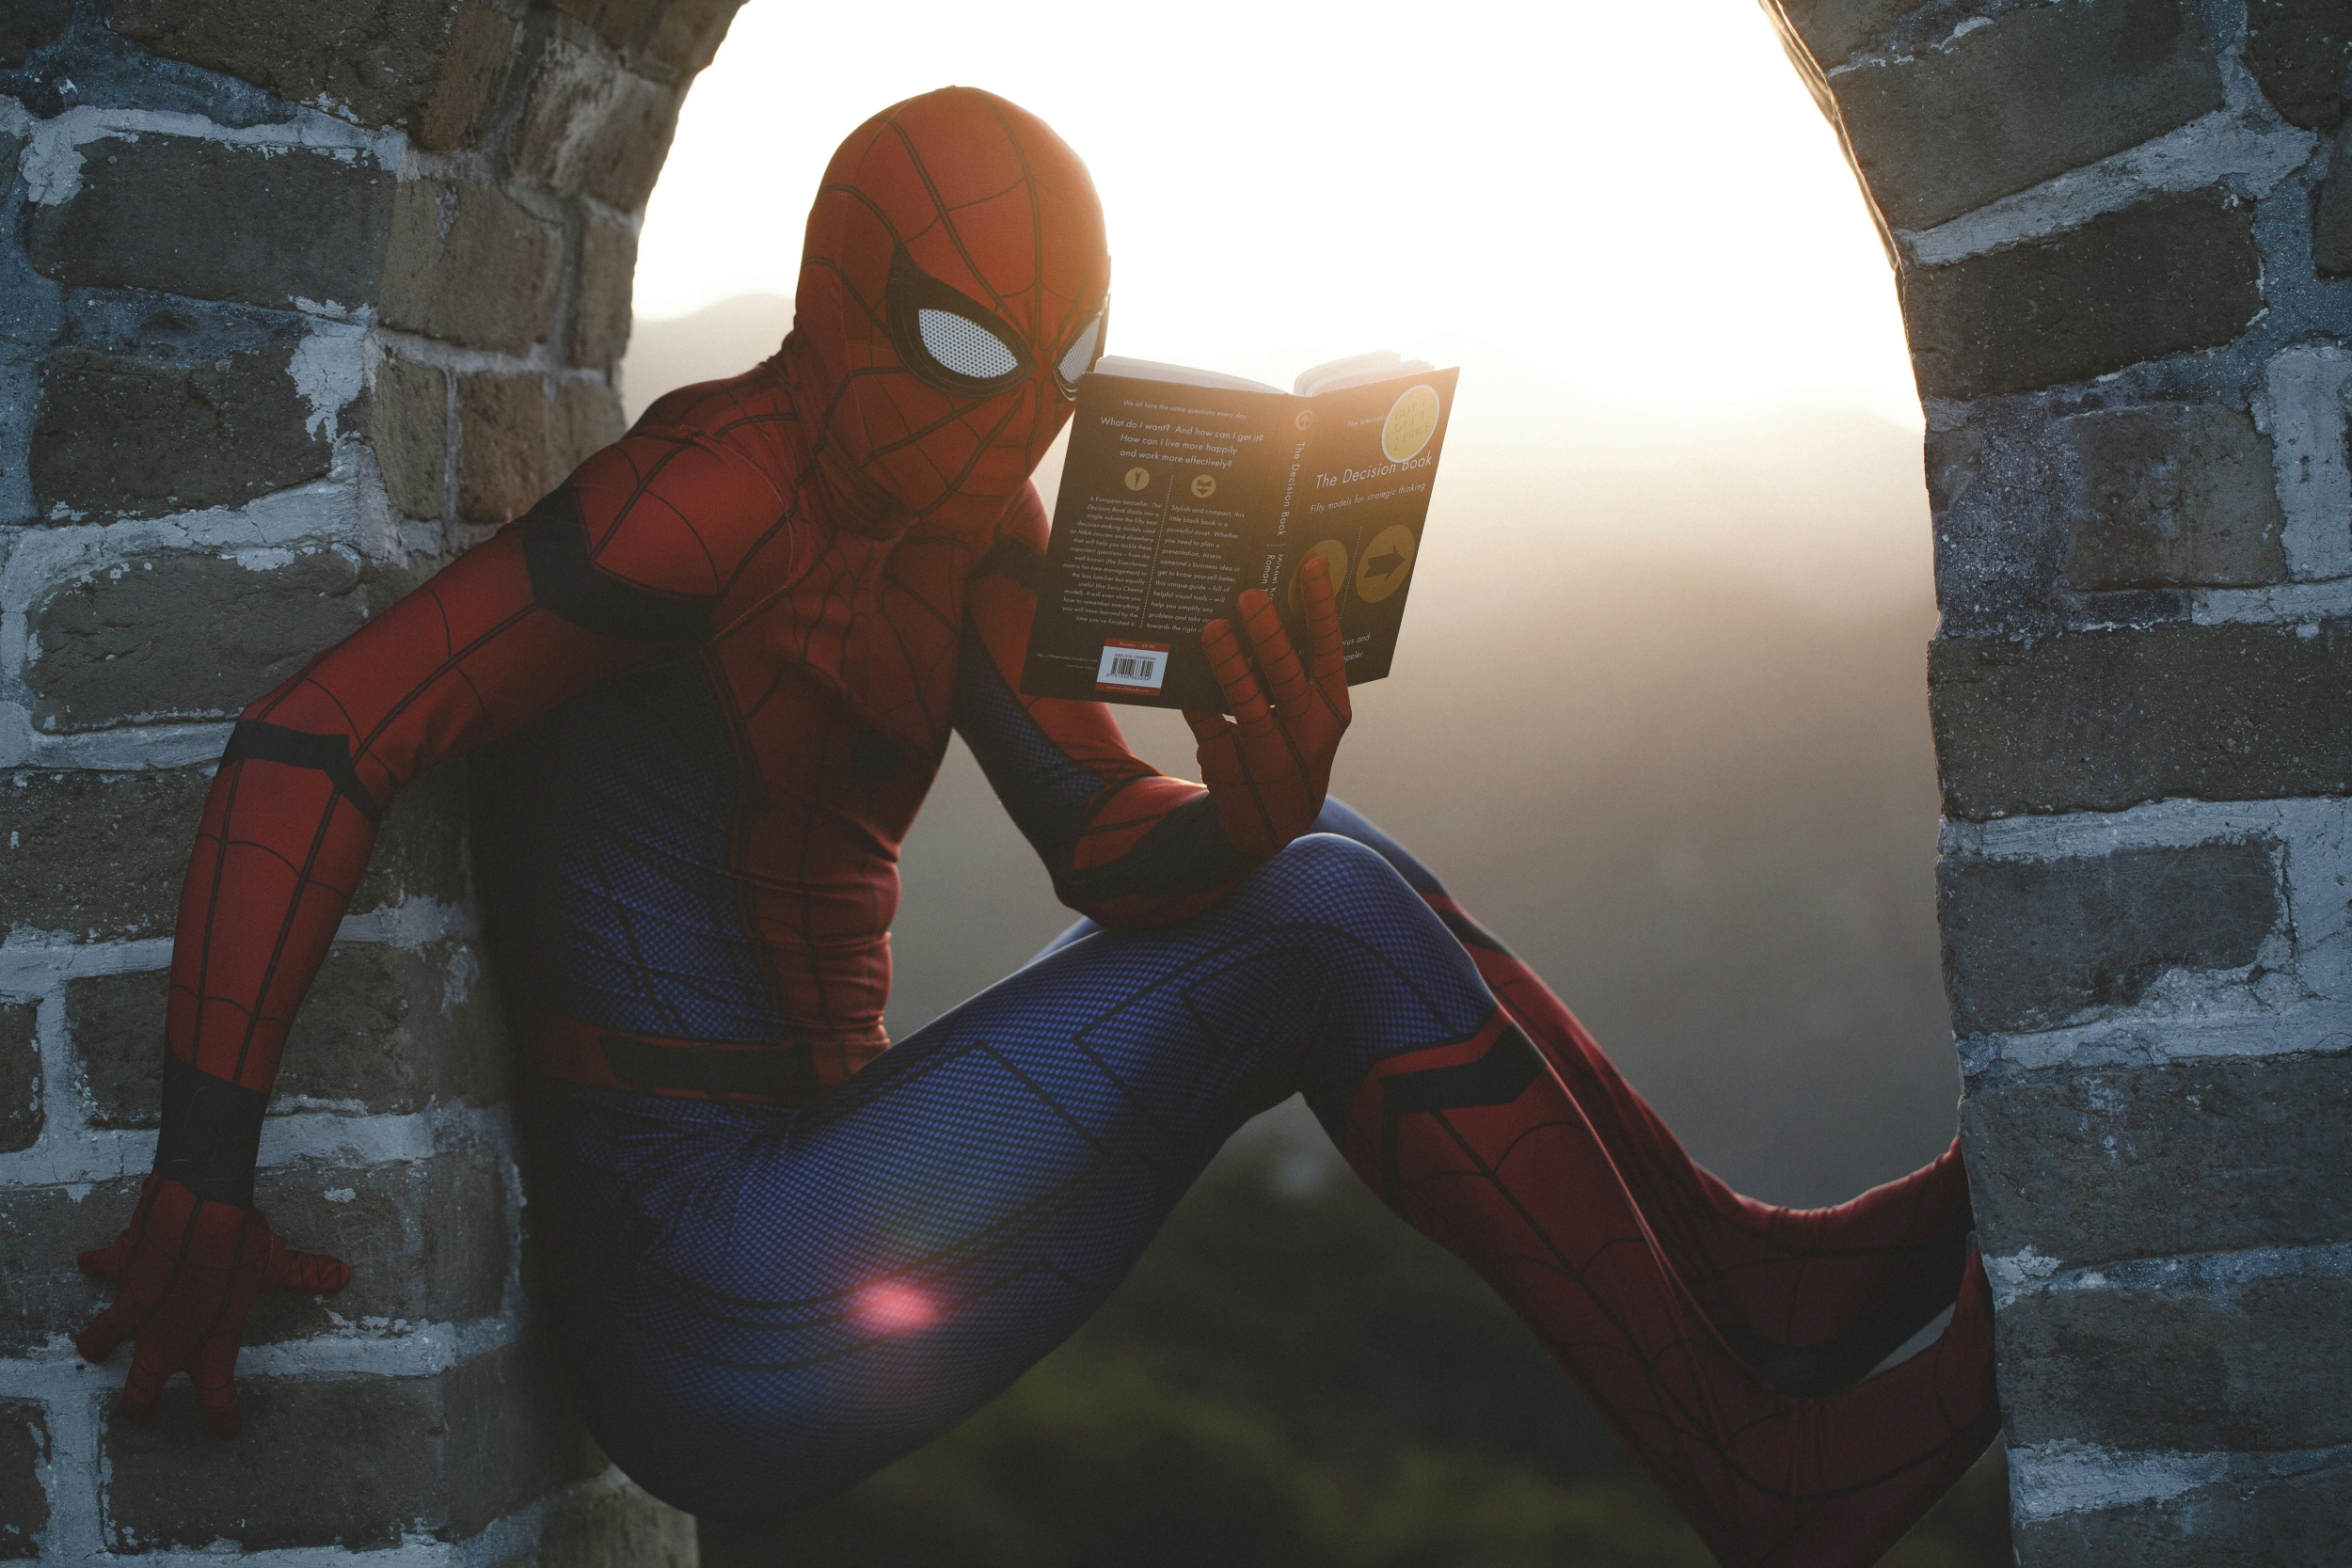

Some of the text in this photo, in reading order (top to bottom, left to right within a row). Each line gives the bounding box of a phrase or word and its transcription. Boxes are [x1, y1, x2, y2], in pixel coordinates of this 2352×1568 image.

[1359, 415, 1388, 425] Internatio
[1395, 402, 1417, 420] BUY
[1101, 417, 1124, 427] What
[1126, 420, 1136, 428] do
[1175, 426, 1192, 435] And
[1195, 428, 1213, 436] how
[1237, 434, 1251, 442] get
[1394, 416, 1414, 432] GET
[1404, 421, 1429, 443] PRICE
[1120, 434, 1140, 443] How
[1166, 438, 1180, 448] live
[1183, 442, 1203, 451] more
[1206, 443, 1237, 455] happily
[1162, 454, 1183, 463] more
[1185, 456, 1232, 469] effectively?
[1316, 451, 1432, 489] The Decision Book
[1277, 441, 1305, 536] The Decision Book
[1311, 483, 1425, 514] Fifty models for strategic thinking
[1162, 549, 1200, 558] presentation,
[1193, 562, 1217, 570] business
[1262, 554, 1275, 584] Roman
[1272, 553, 1283, 584] Mikael
[1357, 632, 1371, 642] and
